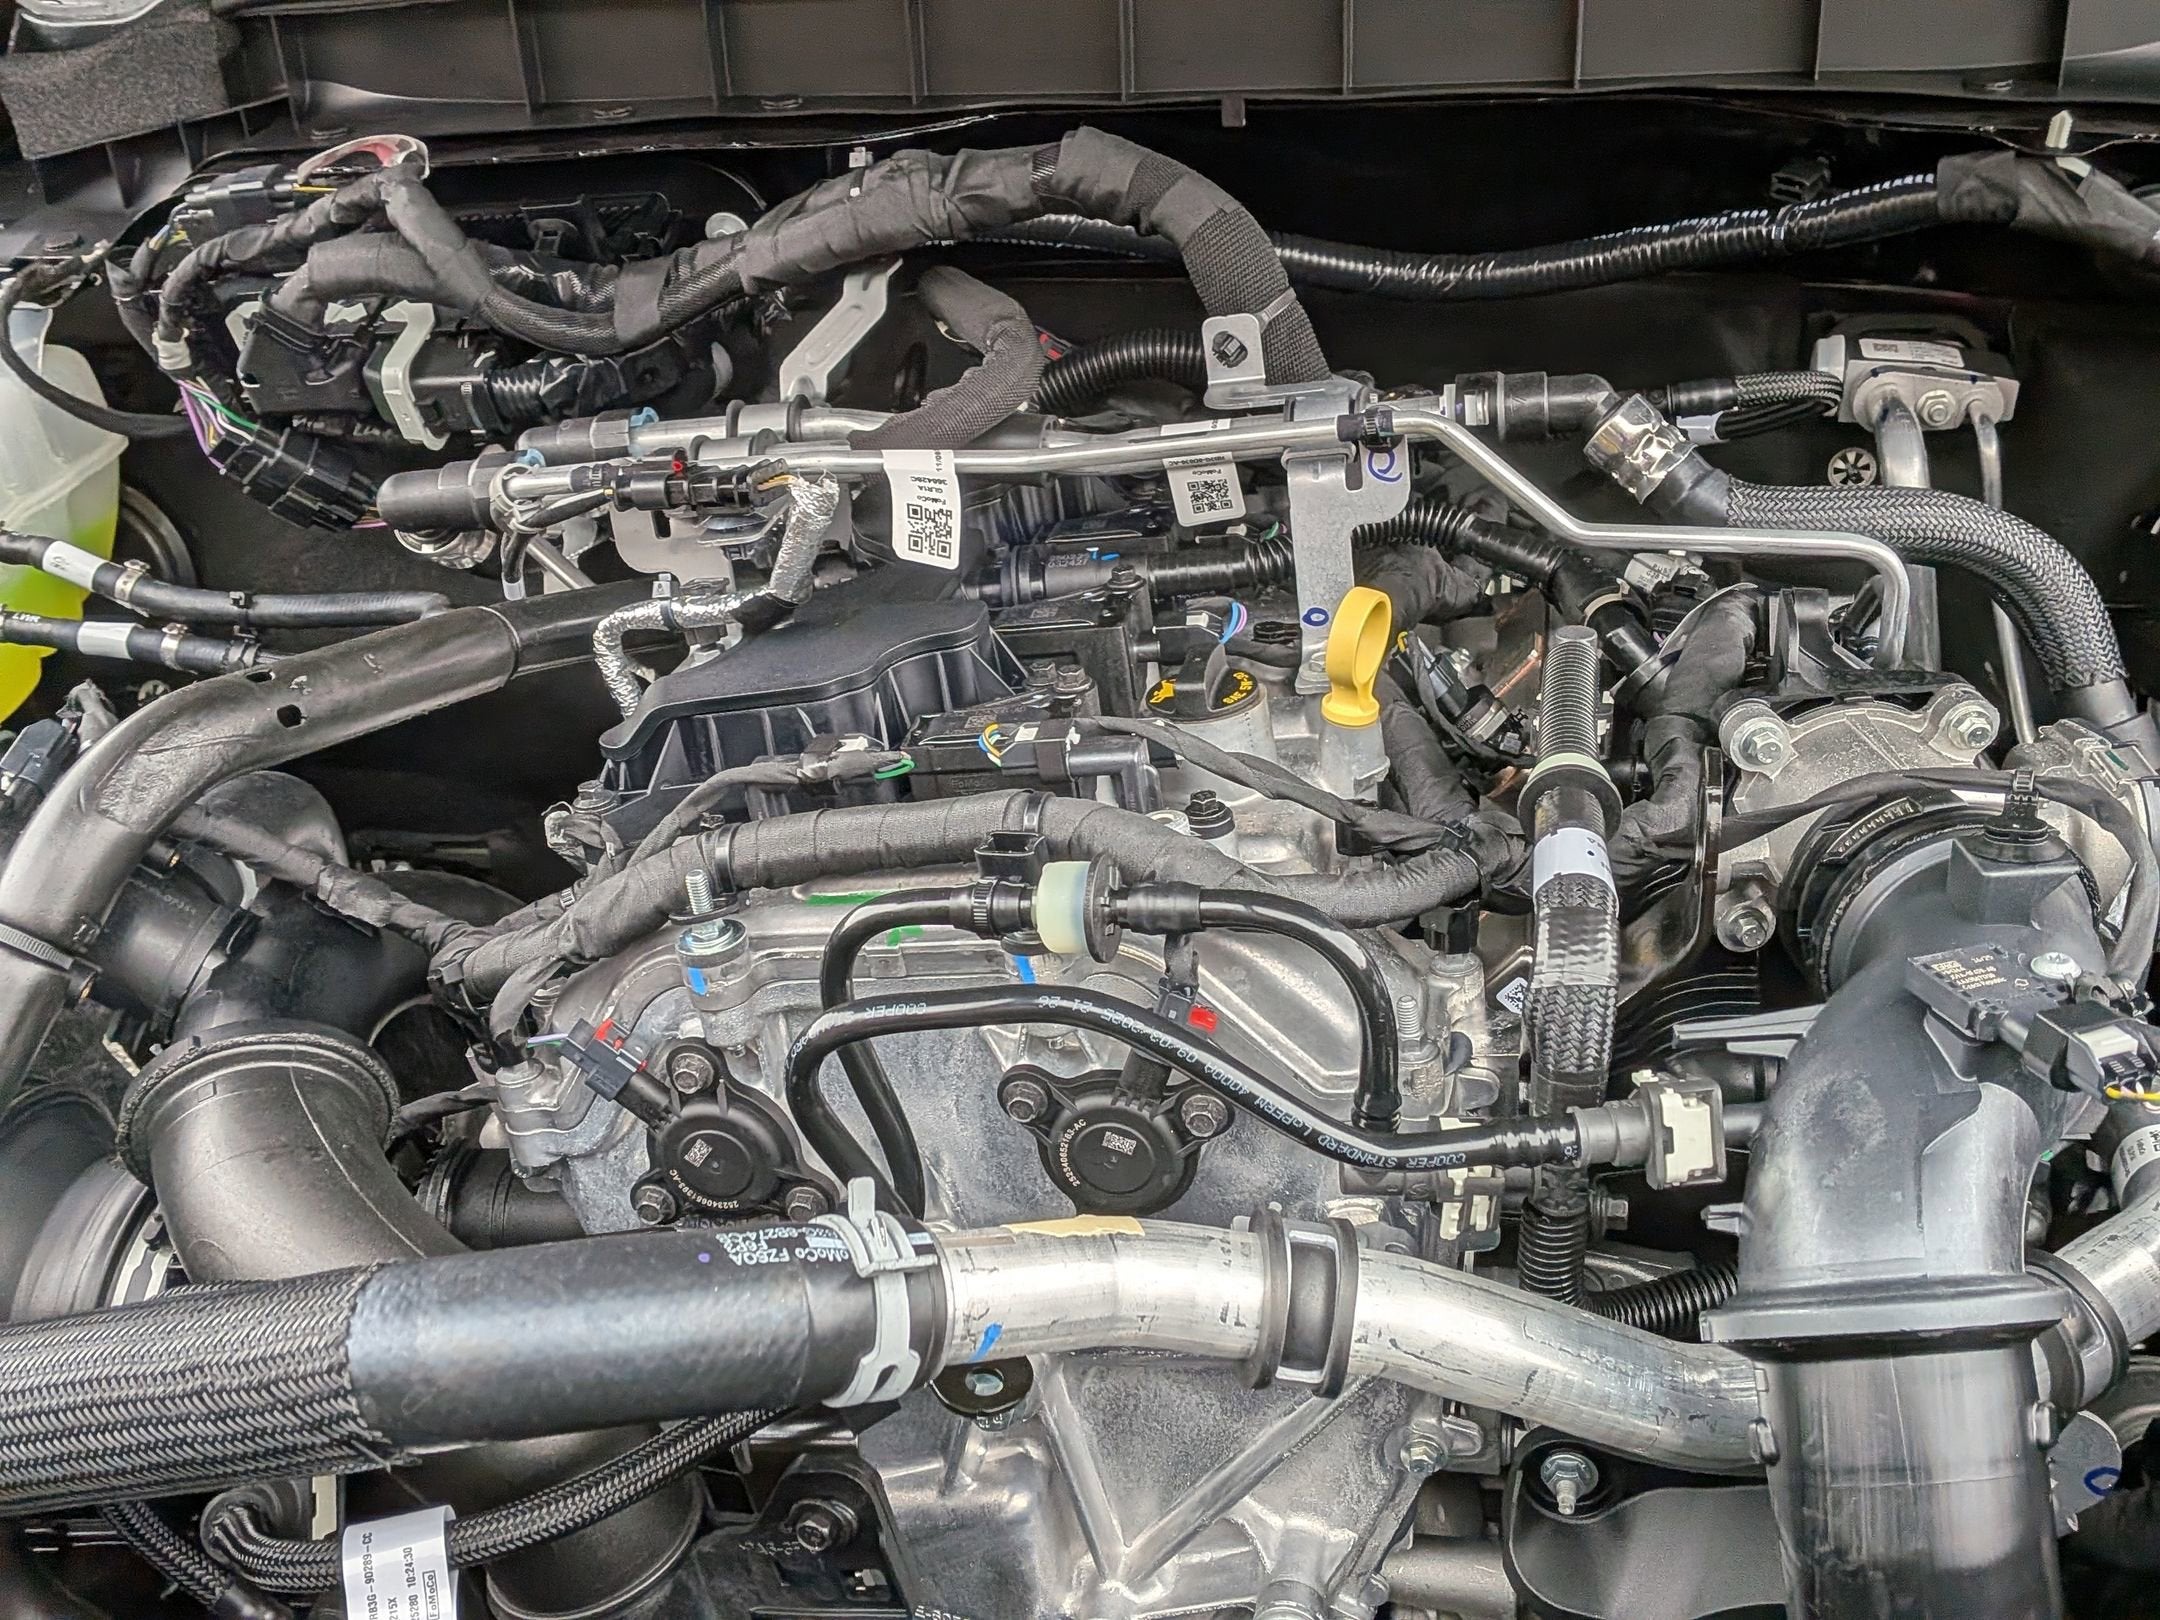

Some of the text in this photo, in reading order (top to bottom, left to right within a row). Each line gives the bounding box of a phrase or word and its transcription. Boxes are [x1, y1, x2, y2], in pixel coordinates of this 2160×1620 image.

[916, 494, 947, 506] FoMoCo
[864, 1002, 928, 1019] COOPER
[1317, 1134, 1398, 1169] STANDARD
[793, 1247, 850, 1263] oMoCo
[402, 1547, 417, 1588] 10:24:30
[426, 1574, 438, 1618] FoMoCo
